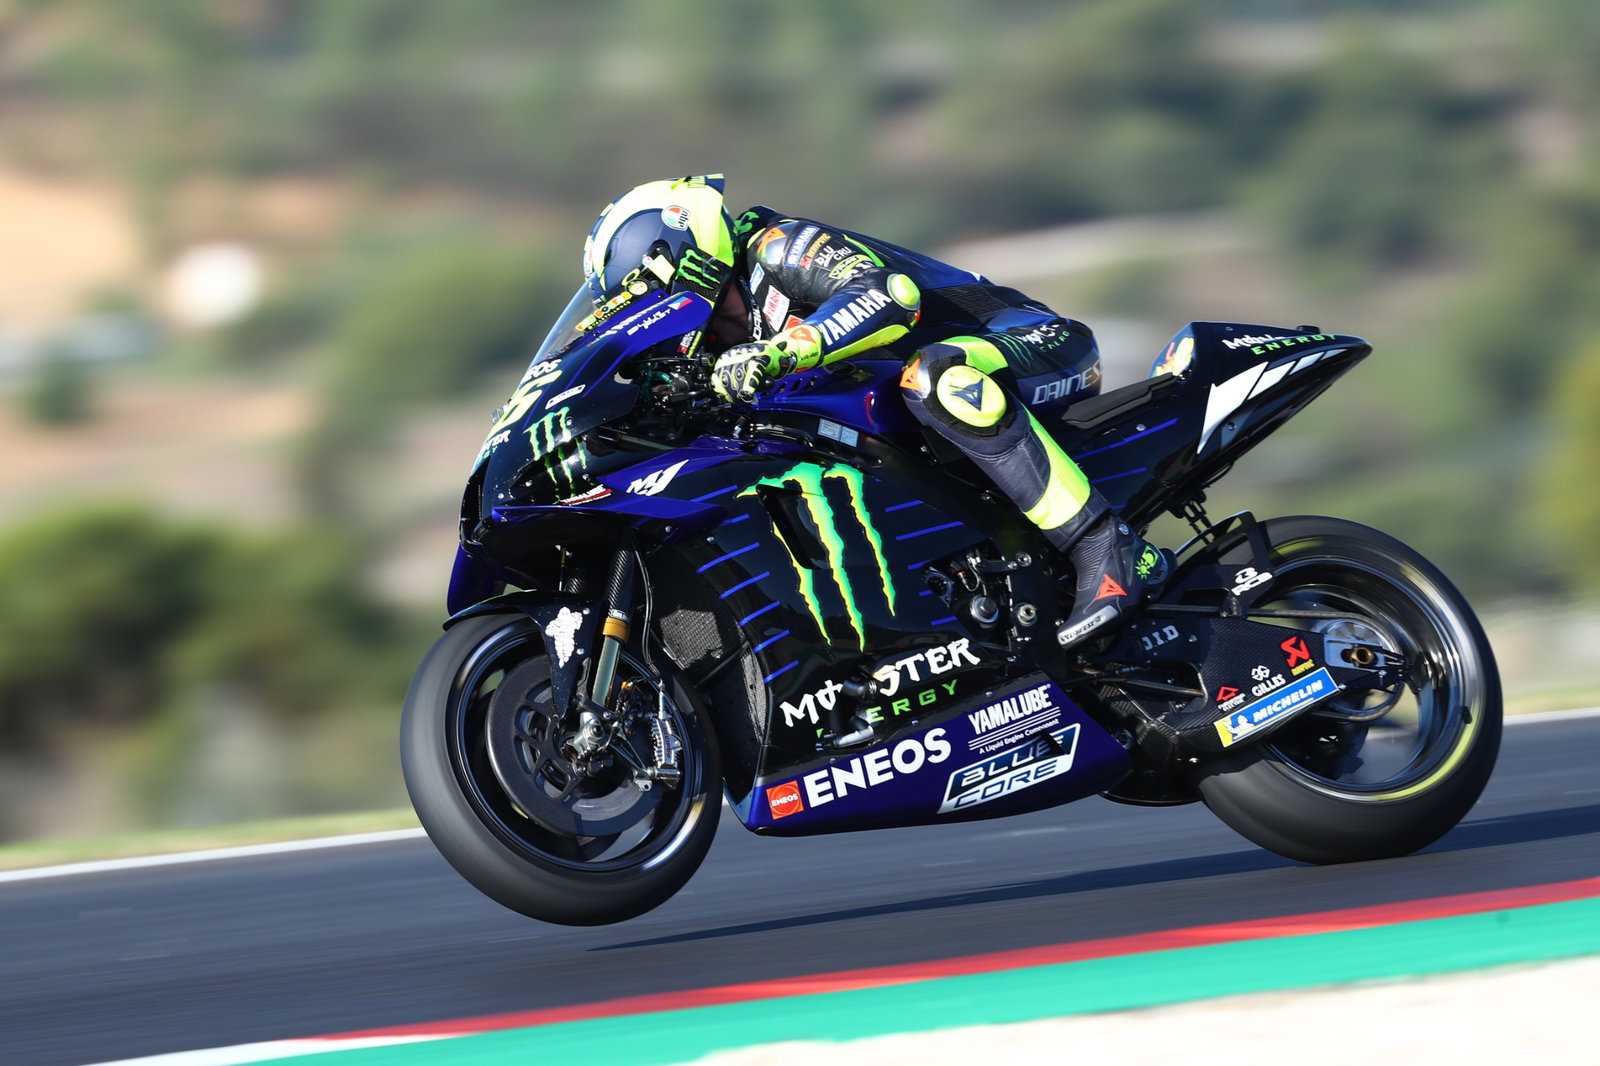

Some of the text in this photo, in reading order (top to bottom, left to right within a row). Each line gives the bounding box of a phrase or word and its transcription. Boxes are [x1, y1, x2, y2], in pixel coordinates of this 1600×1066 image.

[816, 288, 892, 346] YAMAHA
[779, 637, 981, 728] MOSTER
[1251, 673, 1287, 697] GILLES
[1252, 679, 1324, 723] MICHELIN
[968, 685, 1052, 735] YAMALUBE
[985, 738, 1004, 752] Liquid
[1004, 732, 1025, 746] Engine
[1024, 718, 1060, 737] Component
[803, 727, 952, 808] ENEOS
[954, 759, 1058, 809] CORE
[961, 734, 1064, 787] BLUE
[770, 792, 799, 807] ENEOS
